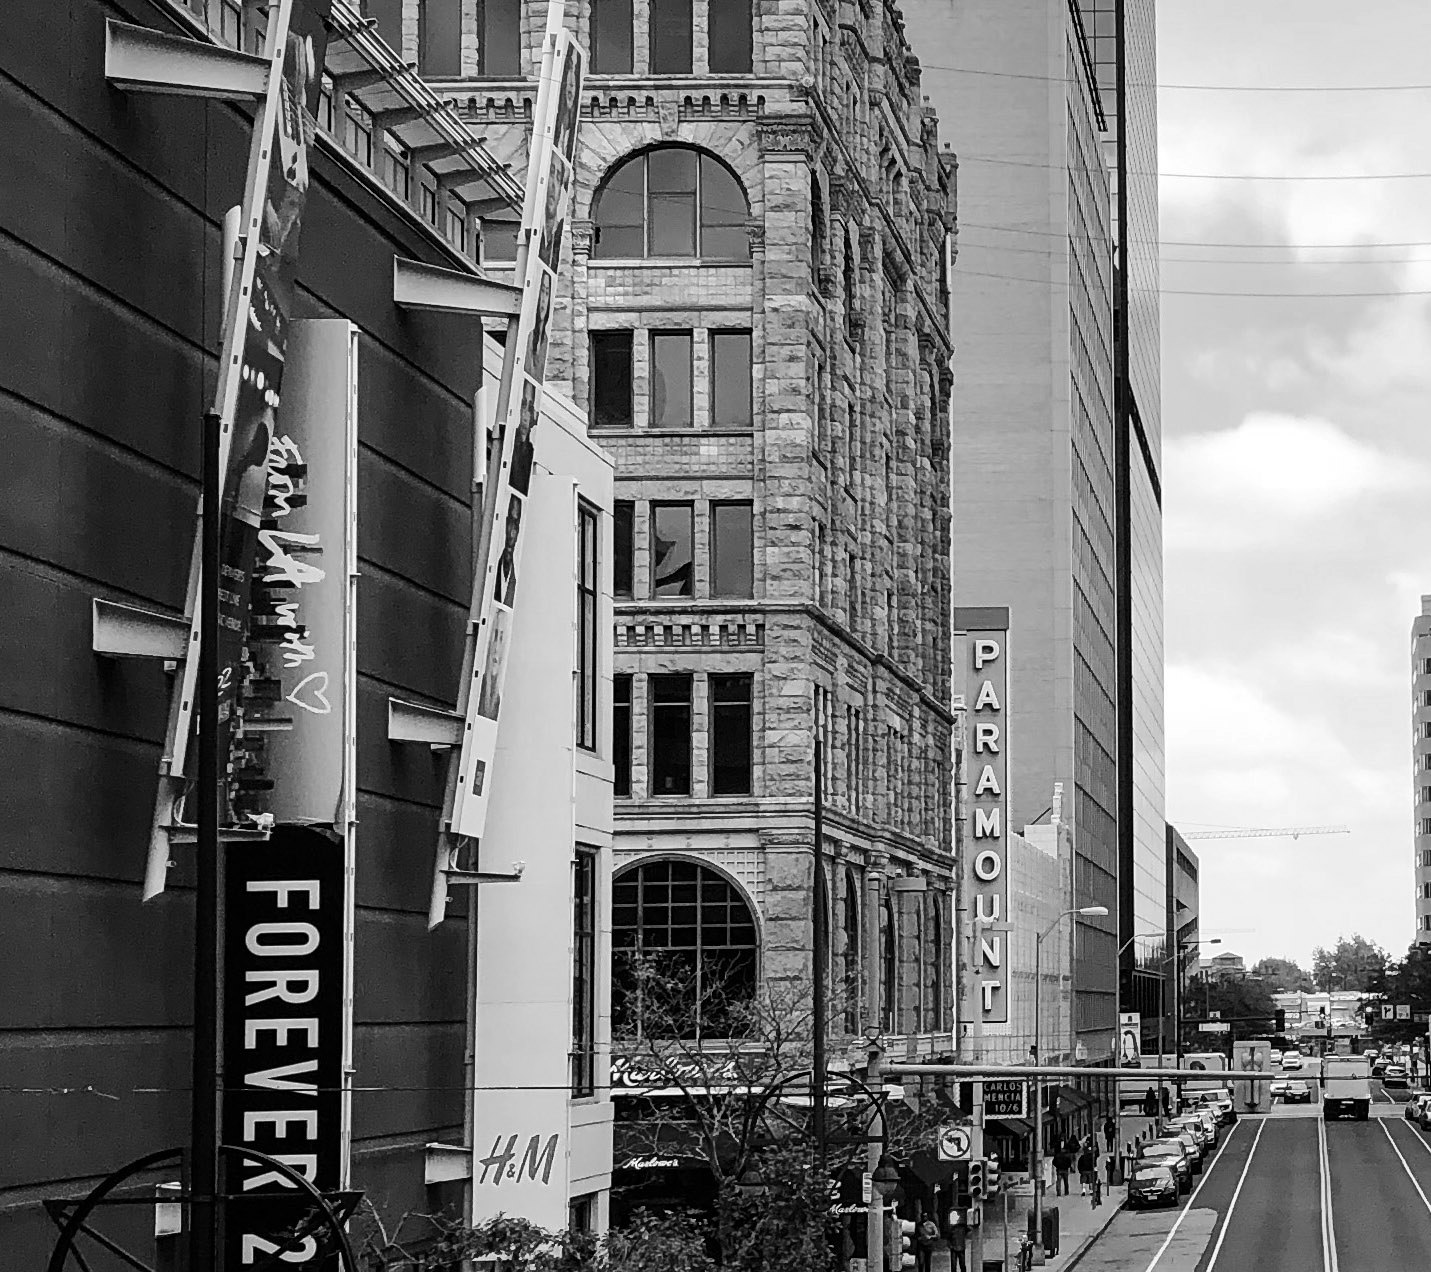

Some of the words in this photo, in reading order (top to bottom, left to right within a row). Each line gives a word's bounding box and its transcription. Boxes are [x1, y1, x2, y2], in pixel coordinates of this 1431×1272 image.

[271, 434, 305, 518] From
[258, 529, 326, 588] LA
[275, 603, 315, 668] with
[975, 639, 1002, 1010] PARAMOUNT
[244, 880, 320, 1192] FOREVER
[983, 1081, 1022, 1091] CARLOS
[983, 1092, 1022, 1102] MENCIA
[994, 1103, 1020, 1113] 10/6
[479, 1133, 559, 1185] H&M
[621, 1156, 679, 1170] Marlowe's
[830, 1203, 869, 1215] Marlow
